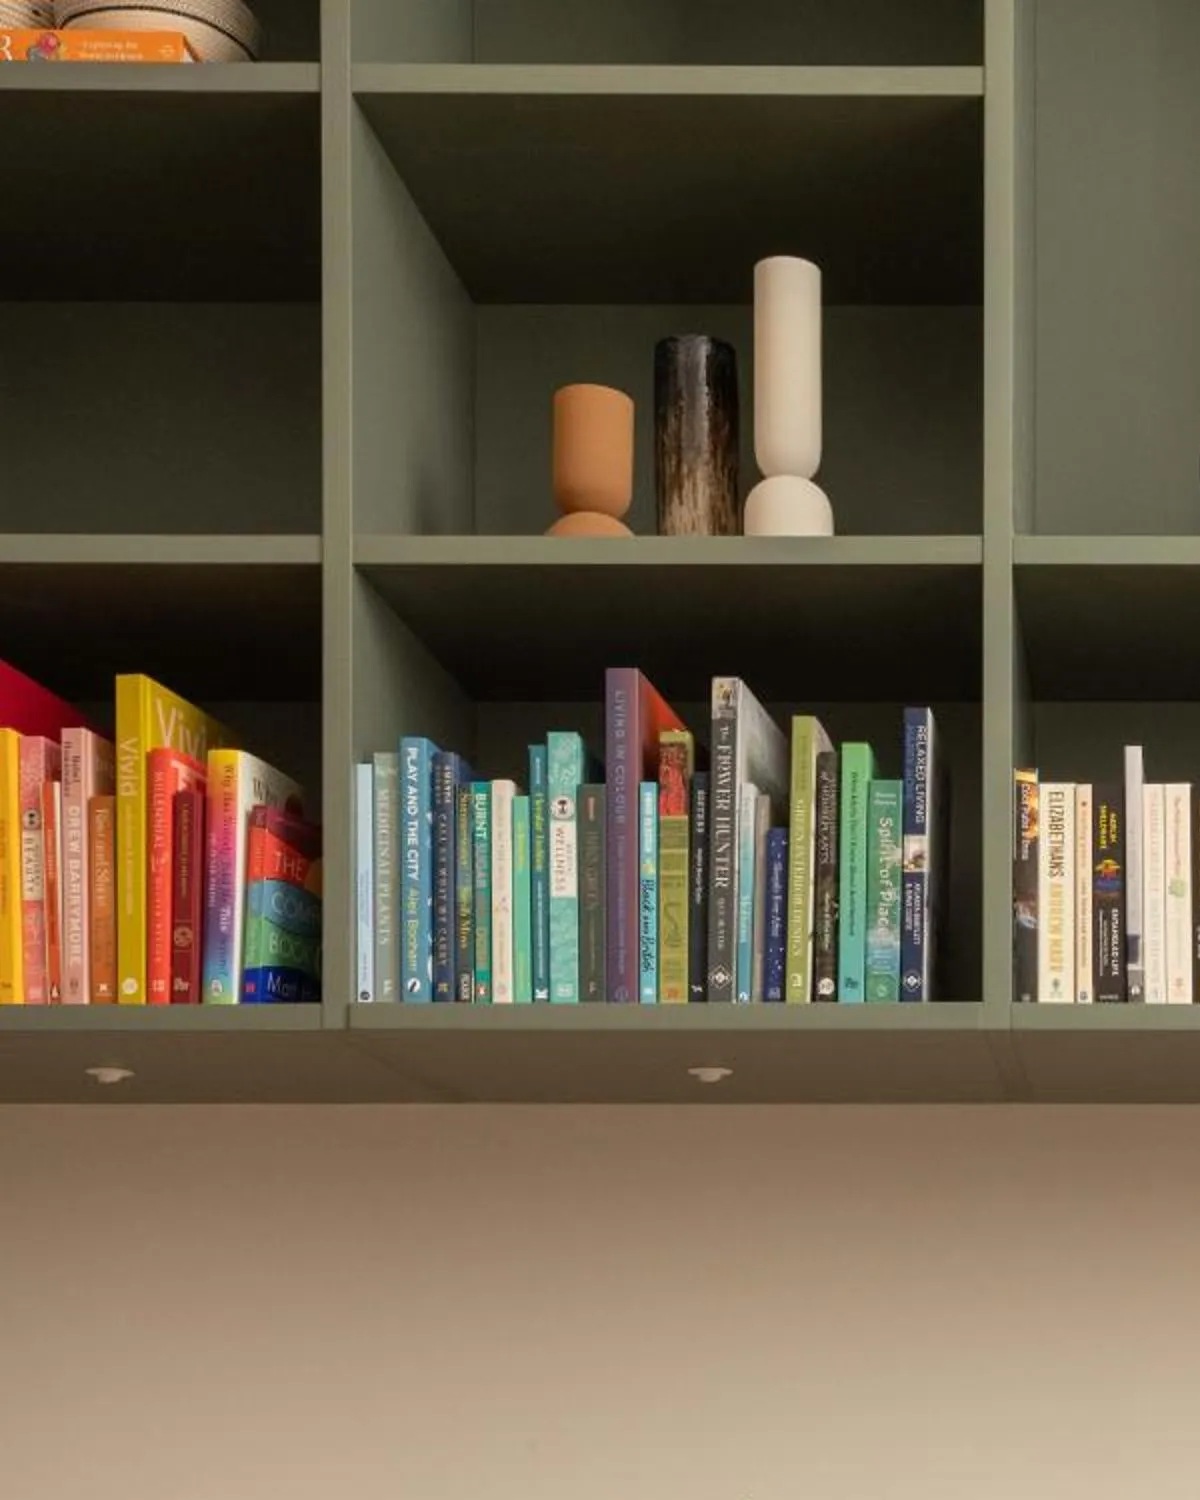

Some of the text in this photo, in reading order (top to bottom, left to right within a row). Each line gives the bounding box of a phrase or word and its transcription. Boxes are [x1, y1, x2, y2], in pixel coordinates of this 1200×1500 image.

[615, 690, 626, 738] LIVING
[119, 737, 140, 796] Vivid
[406, 747, 419, 780] PLAY
[615, 745, 626, 759] IN
[715, 744, 732, 810] FLOWER
[915, 725, 926, 824] RELAXED LIVING
[406, 786, 419, 815] AND
[475, 793, 487, 839] BURNT
[615, 765, 626, 824] COLOUR
[406, 820, 419, 845] THE
[714, 817, 731, 889] HUNTER
[1047, 791, 1064, 878] ELIZABETHANS
[69, 806, 81, 967] DREW BARRYMORE
[377, 788, 390, 944] MEDICINAL PLANTS
[406, 851, 419, 881] CITY
[876, 816, 893, 940] Spirit of Place
